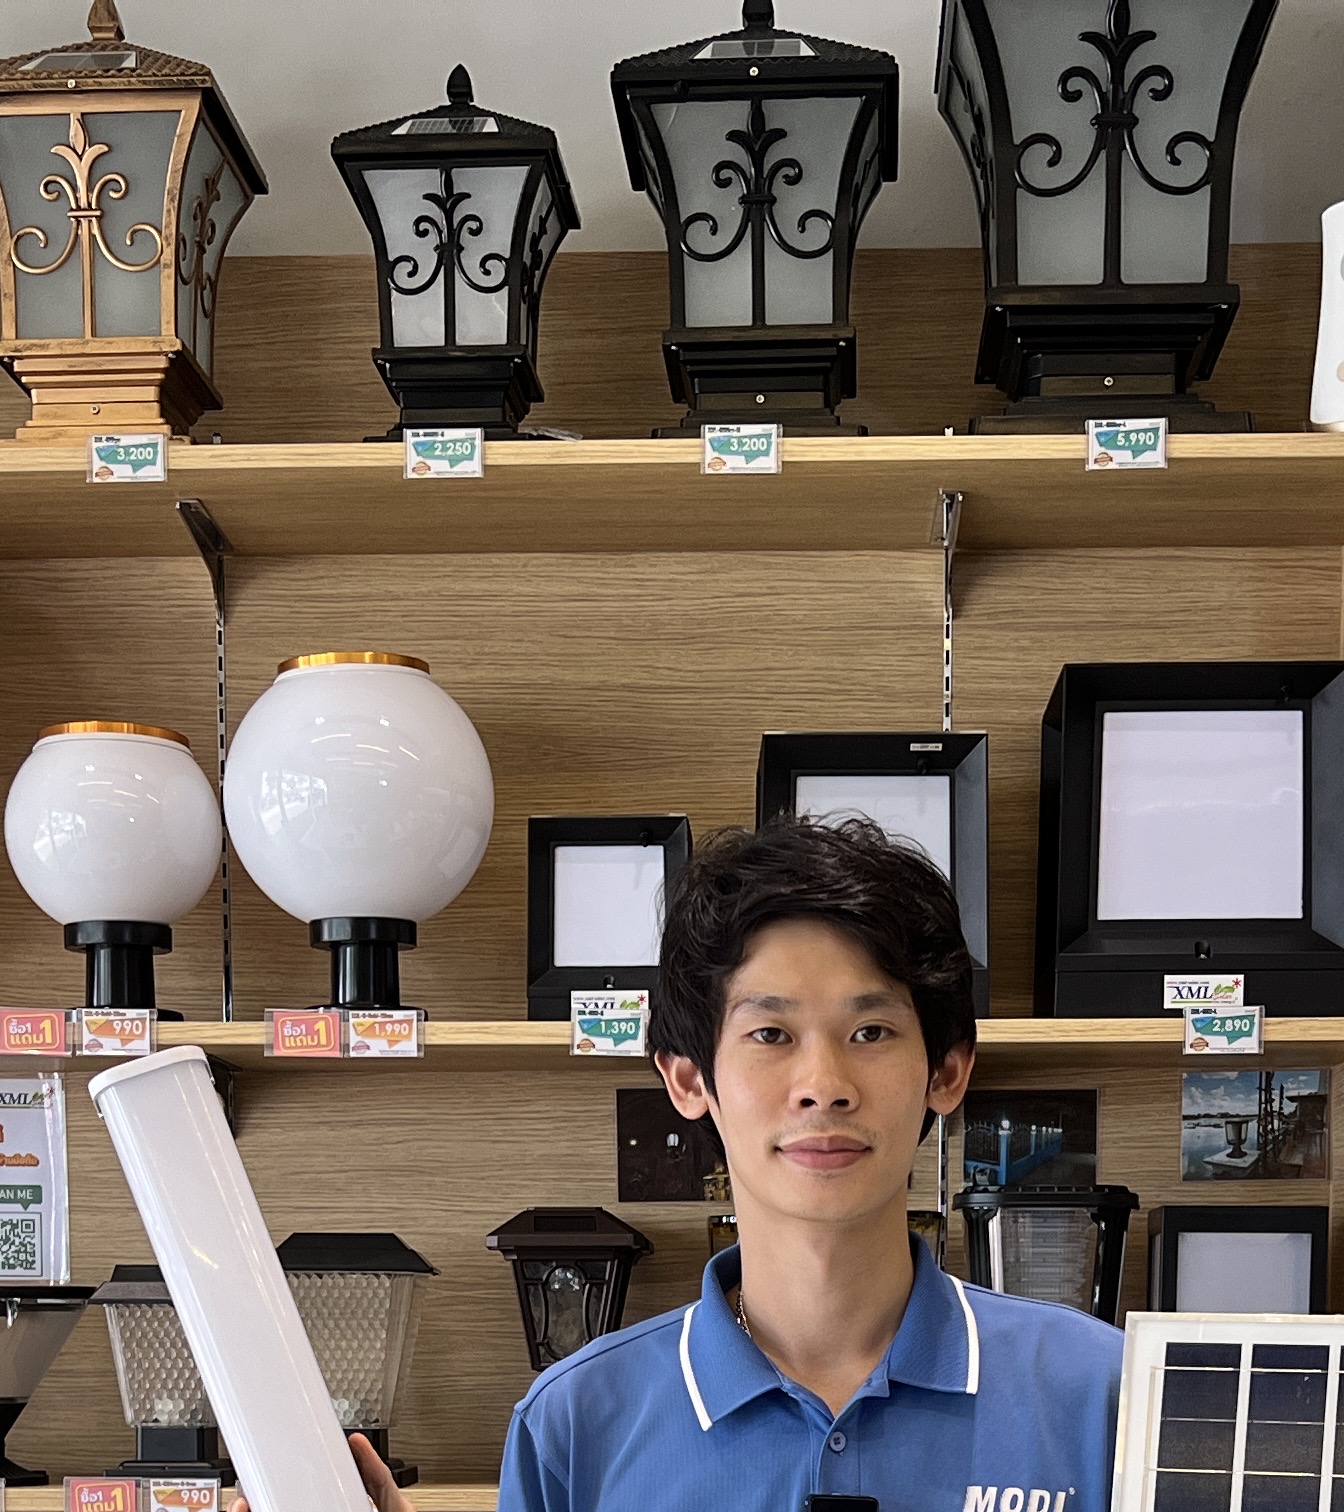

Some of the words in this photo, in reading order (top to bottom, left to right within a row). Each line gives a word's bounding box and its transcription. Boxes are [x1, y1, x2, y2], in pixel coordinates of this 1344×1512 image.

[730, 438, 768, 452] 3,200
[1116, 431, 1155, 446] 5,990
[116, 447, 154, 461] 3,200
[434, 443, 472, 458] 2,250
[1166, 986, 1214, 1000] XML
[112, 1019, 144, 1036] 990
[372, 1021, 409, 1037] 1,990
[599, 1019, 636, 1036] 1,390
[1212, 1018, 1250, 1033] 2,890
[17, 1189, 34, 1200] ME
[180, 1489, 211, 1504] 990
